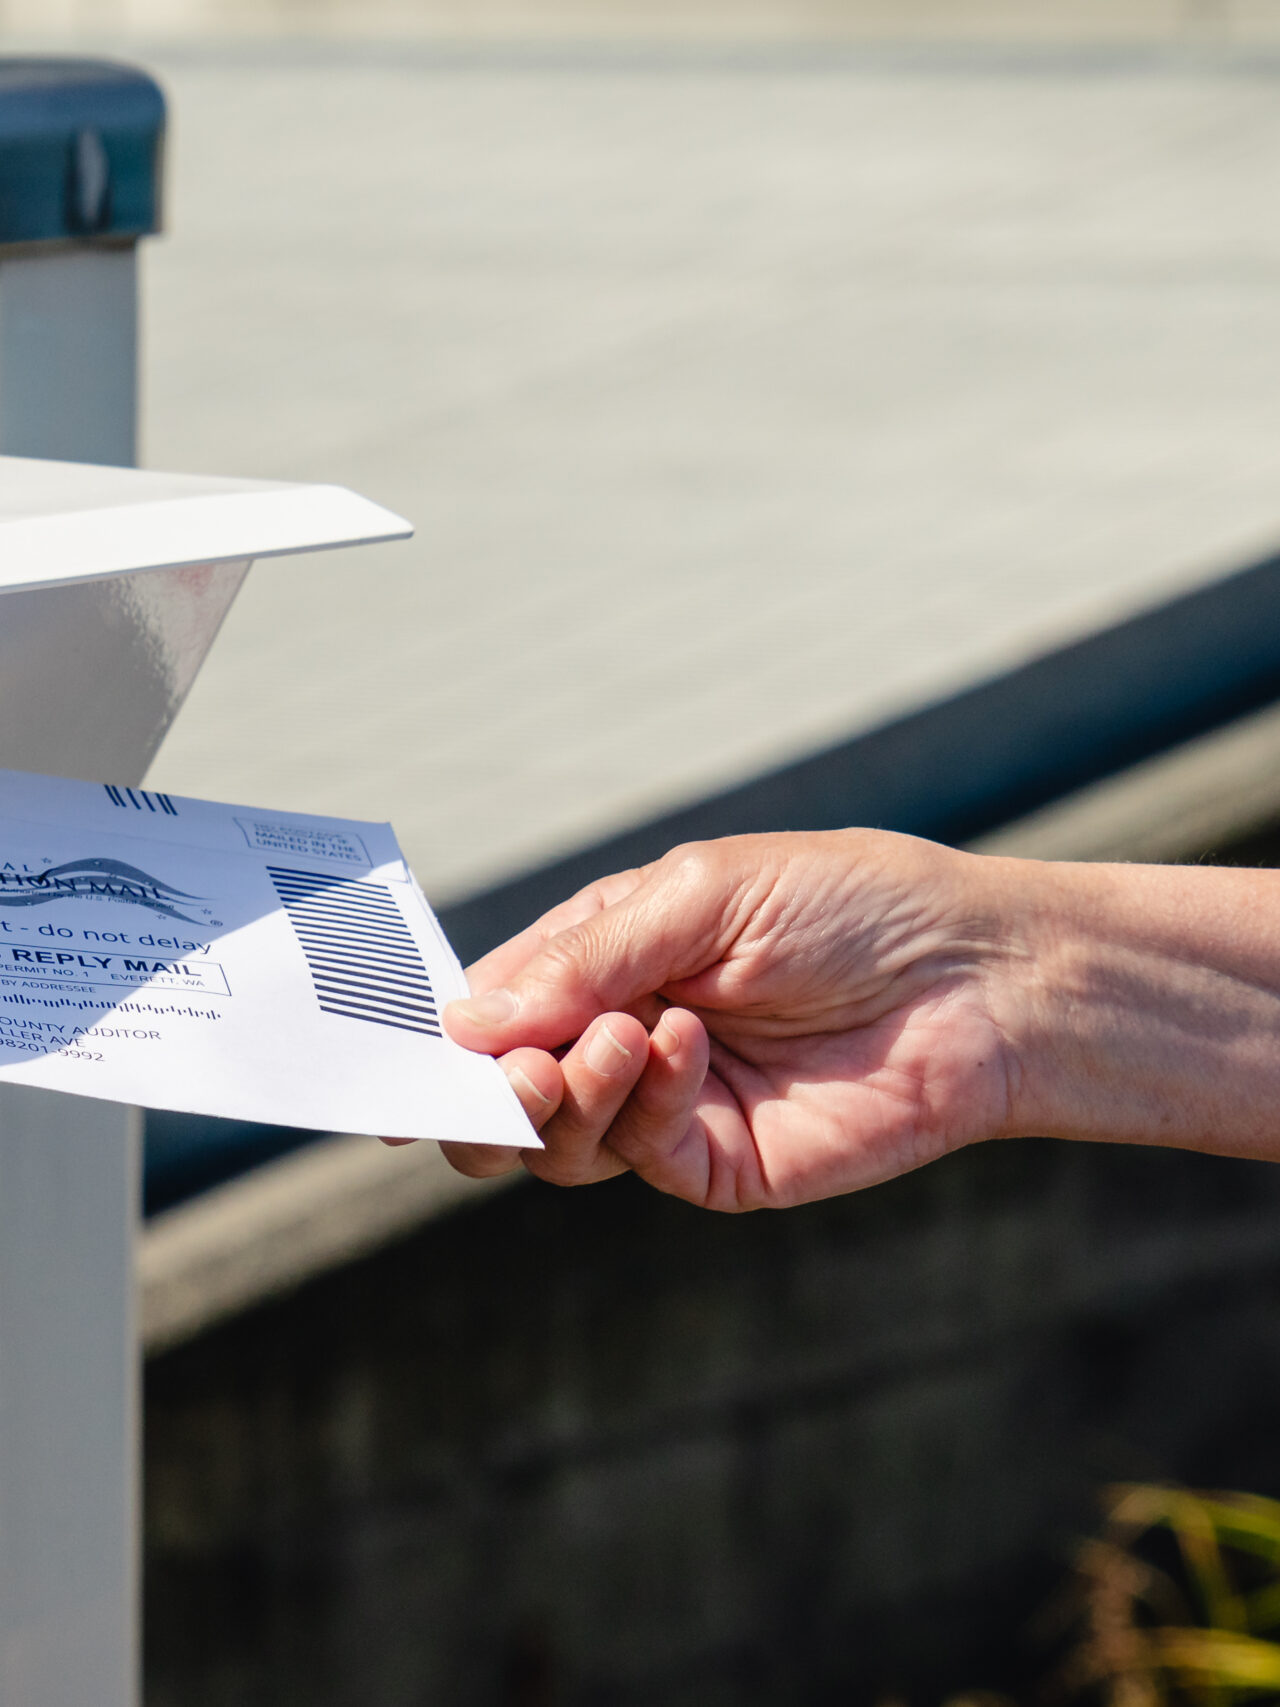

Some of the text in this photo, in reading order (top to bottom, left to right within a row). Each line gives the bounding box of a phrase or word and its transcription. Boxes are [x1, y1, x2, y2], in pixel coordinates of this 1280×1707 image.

[255, 831, 307, 845] MAILED
[311, 840, 326, 848] IN
[330, 843, 356, 852] THE
[256, 838, 362, 861] UNITED STATES
[89, 881, 172, 900] MAIL
[38, 923, 74, 938] do
[83, 929, 131, 944] not
[139, 933, 211, 954] delay
[12, 948, 113, 970] REPLY
[123, 959, 202, 977] MAIL
[1, 978, 17, 987] BY
[21, 981, 96, 993] ADDRESSEE
[53, 968, 76, 977] NO.
[182, 978, 206, 987] WA
[50, 1036, 86, 1048] AVE
[72, 1026, 162, 1041] AUDITOR
